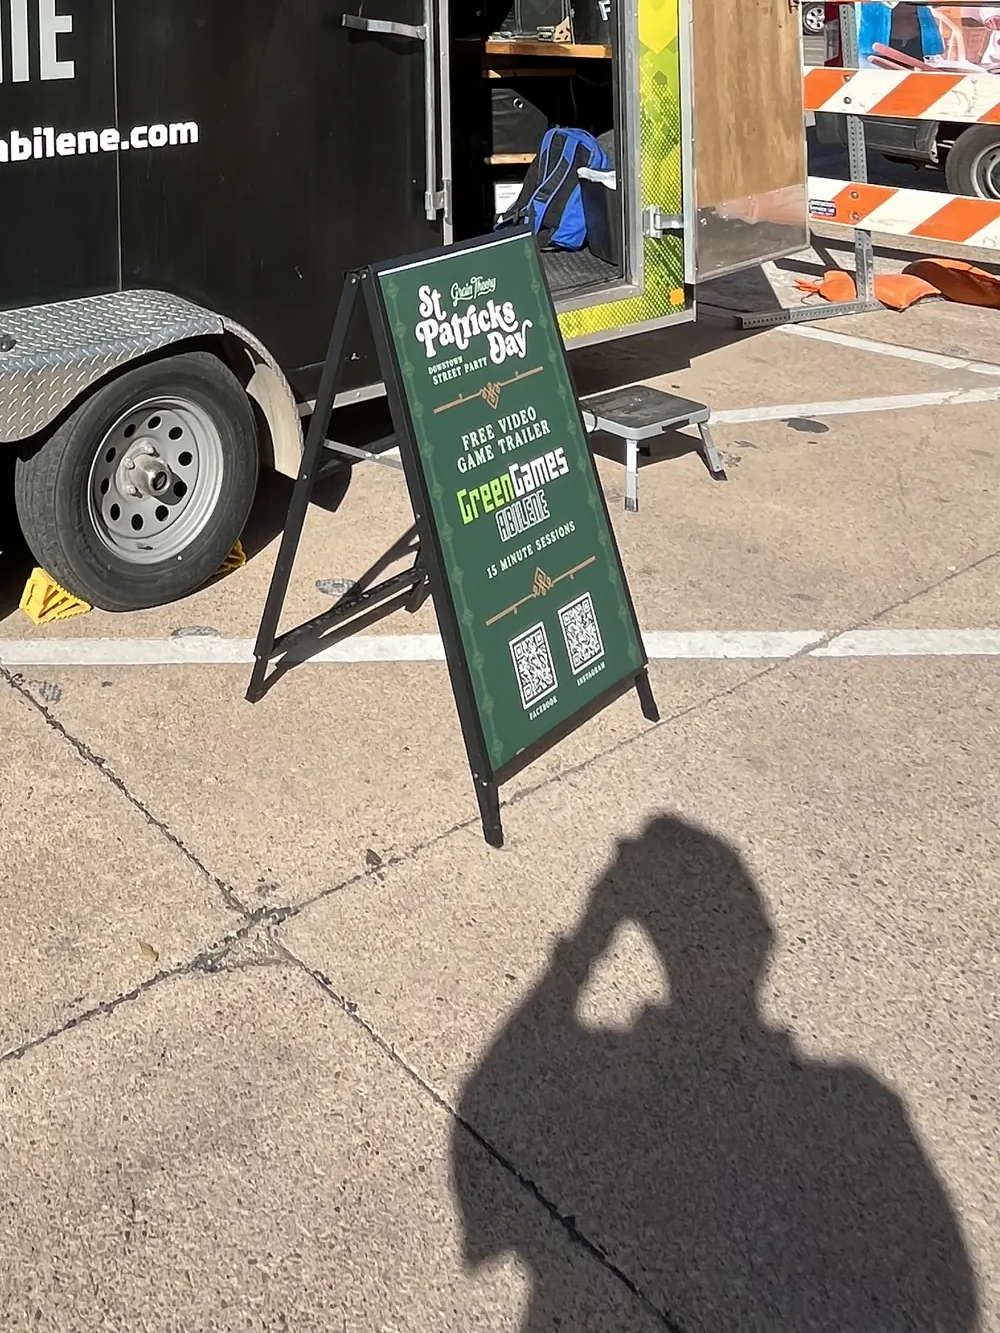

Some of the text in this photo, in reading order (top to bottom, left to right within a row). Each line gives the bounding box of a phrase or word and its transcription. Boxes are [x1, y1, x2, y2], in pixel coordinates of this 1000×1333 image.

[418, 285, 447, 321] St
[451, 276, 496, 306] Grain Theory
[415, 299, 519, 358] Patricks
[487, 320, 533, 364] Day
[428, 355, 464, 375] DOWNTOWN
[432, 357, 488, 386] STREET PARTY
[457, 419, 551, 474] GAME TRAILER
[462, 406, 537, 452] FREE VIDEO
[496, 489, 551, 543] ABILENE
[486, 520, 577, 579] 15 MINUTE SESSIONS
[576, 661, 606, 687] INSTAGRAM
[529, 695, 558, 720] FACEBOOK
